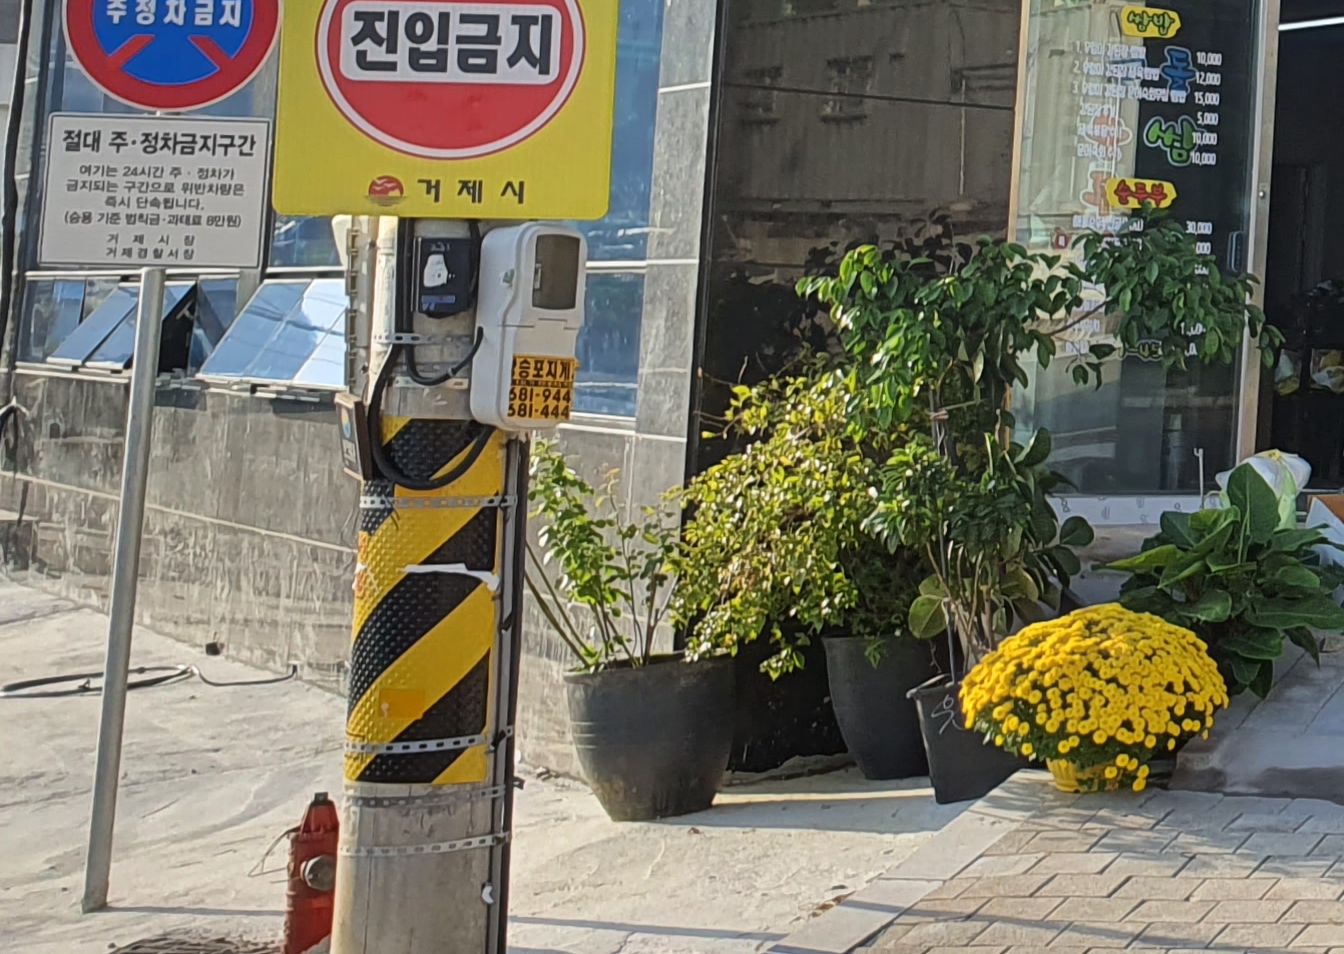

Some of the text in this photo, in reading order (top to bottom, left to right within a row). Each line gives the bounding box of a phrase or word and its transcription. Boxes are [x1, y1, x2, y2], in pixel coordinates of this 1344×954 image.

[1127, 10, 1176, 36] 쌈밥
[351, 10, 553, 75] 진입금지
[1196, 51, 1222, 66] 10,000
[1195, 72, 1221, 86] 12,000
[1194, 92, 1220, 106] 15,000
[1197, 112, 1219, 125] 5,000
[62, 129, 101, 152] 절대
[1192, 132, 1217, 146] 10,000
[1190, 152, 1217, 166] 10,000
[79, 165, 117, 177] 여기는
[122, 166, 164, 179] 24시간
[66, 179, 245, 196] 금지되는 구간으로 위반차량은
[417, 179, 525, 205] 거제시
[104, 196, 131, 209] 즉시
[97, 212, 121, 225] 기준
